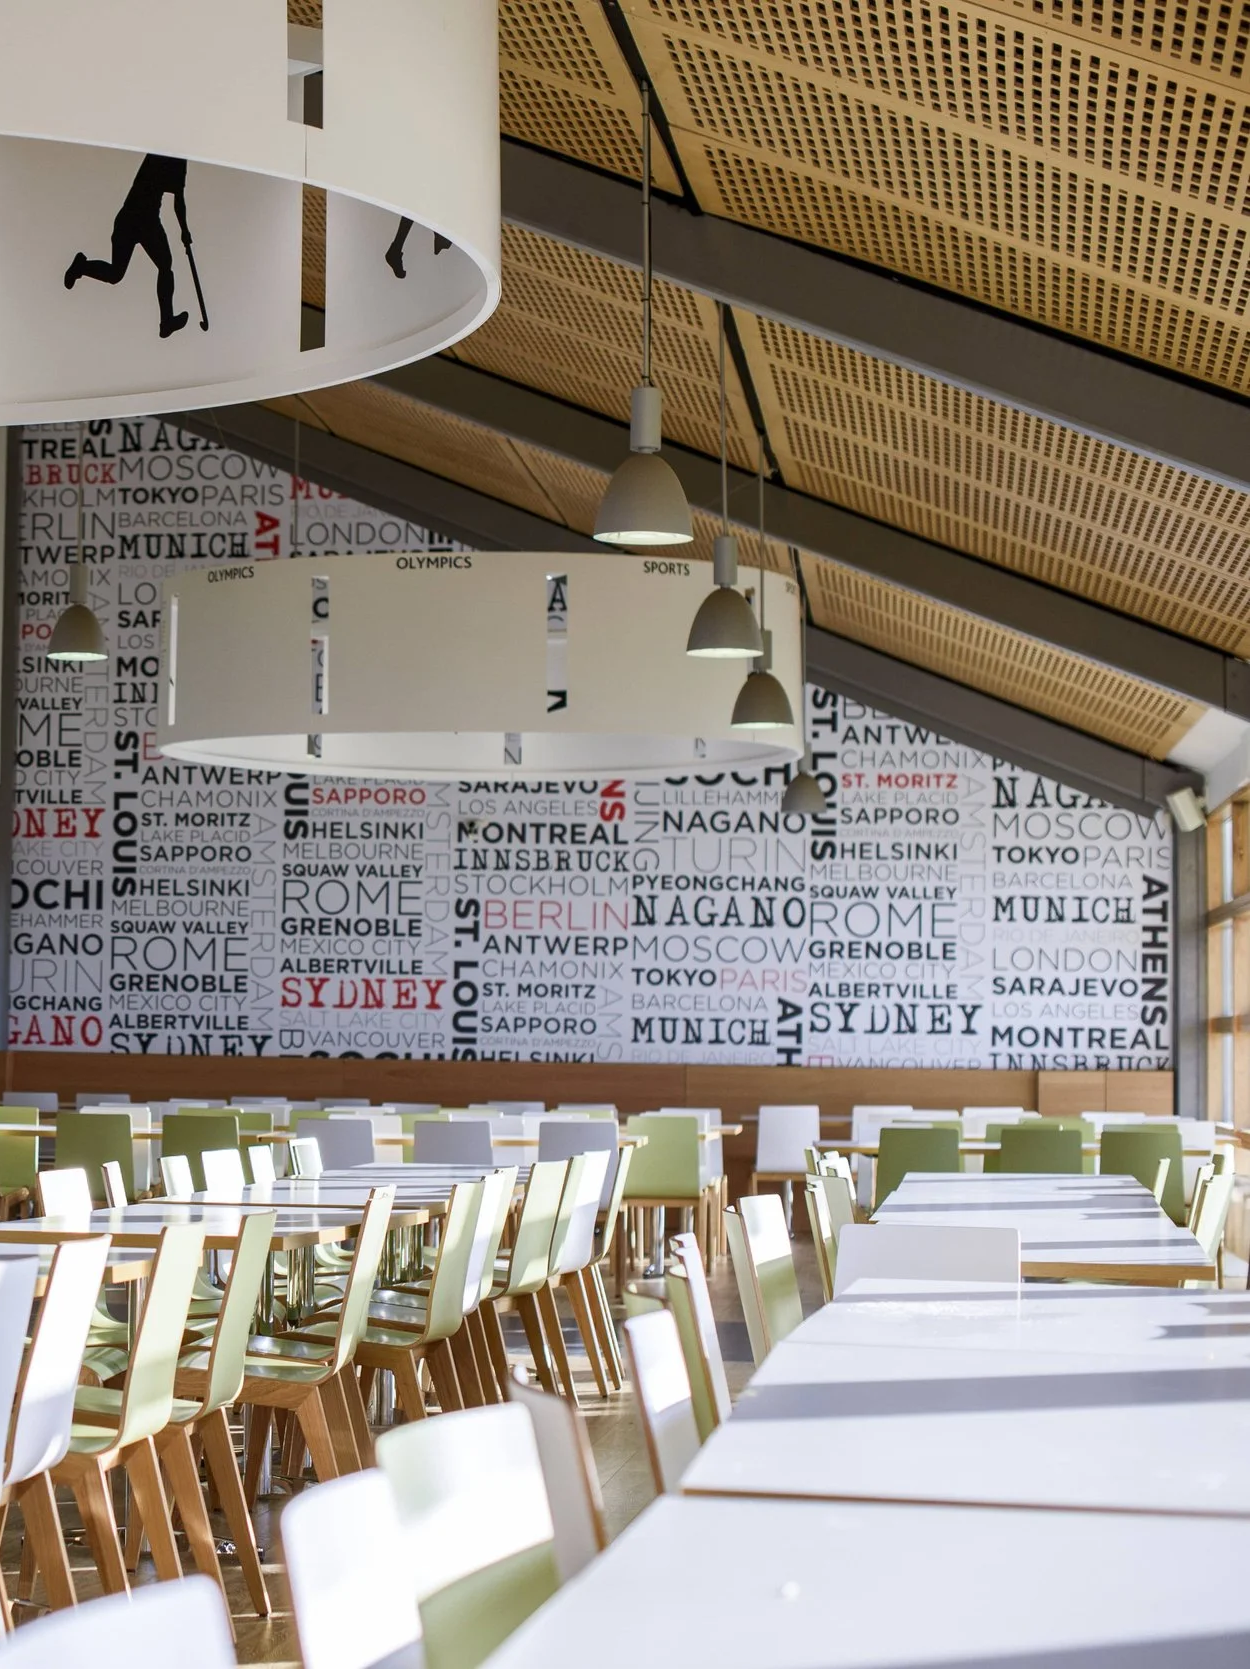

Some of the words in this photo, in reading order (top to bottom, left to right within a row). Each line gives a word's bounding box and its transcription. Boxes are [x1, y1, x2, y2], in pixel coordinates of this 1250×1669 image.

[119, 454, 279, 481] MOSCOW
[119, 486, 199, 505] TOKYO
[202, 484, 284, 506] PARIS
[119, 511, 246, 528] BARCELONA
[290, 522, 424, 546] LONDON
[118, 532, 249, 559] MUNICH
[396, 557, 472, 570] OLYMPICS
[643, 561, 691, 576] SPORTS
[207, 567, 255, 583] OLYMPICS
[118, 634, 153, 650] LOS
[812, 688, 837, 739] ST.
[114, 731, 139, 779] ST.
[841, 750, 986, 769] CHAMONIX
[34, 770, 79, 785] CITY
[141, 766, 281, 785] ANTWERP
[841, 774, 868, 789] ST.
[877, 774, 958, 789] MORITZ
[312, 788, 426, 805] SAPPORO
[458, 781, 598, 794] SARAJEVO
[141, 790, 277, 808] CHAMONIX
[841, 792, 887, 805] LAKE
[895, 792, 958, 805] PLACID
[458, 800, 496, 816] LOS
[503, 800, 597, 816] ANGELES
[841, 808, 960, 826] SAPPORO
[141, 813, 168, 827] ST.
[175, 813, 250, 827] MORITZ
[663, 811, 805, 833] NAGANO
[993, 813, 1165, 840] MOSCOW
[140, 830, 184, 843] LAKE
[190, 830, 250, 843] PLACID
[312, 822, 424, 840] HELSINKI
[457, 823, 629, 845] MONTREAL
[59, 841, 104, 857] CITY
[112, 791, 138, 897] LOUIS
[283, 843, 423, 860] MELBOURNE
[841, 843, 957, 860] HELSINKI
[140, 846, 251, 863] SAPPORO
[453, 849, 630, 872] INNSBRUCK
[663, 837, 805, 873] TURIN
[993, 847, 1079, 864] TOKYO
[1084, 847, 1170, 870] PARIS
[283, 864, 348, 877] SQUAW
[355, 864, 423, 877] VALLEY
[811, 864, 958, 882] MELBOURNE
[140, 880, 249, 897] HELSINKI
[454, 874, 628, 896] STOCKHOLM
[632, 875, 805, 892] PYEONGCHANG
[958, 775, 986, 1000] AMSTERDAM
[993, 872, 1132, 890] BARCELONA
[283, 880, 423, 915] ROME
[810, 886, 879, 899] SQUAW
[887, 886, 957, 900] VALLEY
[111, 900, 249, 917] MELBOURNE
[485, 900, 628, 930] BERLIN
[631, 895, 805, 928] NAGANO
[993, 896, 1136, 924] MUNICH
[111, 921, 177, 935] SQUAW
[182, 921, 249, 935] VALLEY
[251, 813, 276, 1032] AMSTERDAM
[282, 918, 422, 937] GRENOBLE
[454, 898, 480, 947] ST.
[810, 902, 957, 938] ROME
[111, 937, 249, 972] ROME
[281, 938, 364, 956] MEXICO
[372, 938, 420, 956] CITY
[483, 936, 628, 956] ANTWERP
[633, 935, 805, 963] MOSCOW
[809, 941, 957, 960] GRENOBLE
[1141, 874, 1169, 1026] ATHENS
[280, 958, 423, 975] ALBERTVILLE
[993, 947, 1137, 973] LONDON
[482, 959, 623, 980] CHAMONIX
[631, 968, 716, 986] TOKYO
[809, 963, 896, 980] MEXICO
[905, 963, 956, 980] CITY
[110, 974, 248, 993] GRENOBLE
[721, 968, 808, 993] PARIS
[992, 977, 1138, 997] SARAJEVO
[281, 977, 447, 1010] SYDNEY
[483, 983, 509, 997] ST.
[518, 984, 595, 998] MORITZ
[808, 983, 958, 999] ALBERTVILLE
[110, 995, 192, 1011] MEXICO
[199, 995, 247, 1011] CITY
[452, 960, 478, 1061] LOUIS
[481, 1001, 525, 1014] LAKE
[534, 1002, 596, 1015] PLACID
[632, 994, 767, 1011] BARCELONA
[992, 1003, 1032, 1018] LOS
[1040, 1004, 1140, 1020] ANGELES
[109, 1014, 249, 1030] ALBERTVILLE
[279, 1011, 333, 1029] SALT
[337, 1011, 394, 1029] LAKE
[400, 1011, 445, 1029] CITY
[481, 1017, 597, 1035] SAPPORO
[810, 1002, 983, 1035] SYDNEY
[307, 1031, 445, 1049] VANCOUVER
[631, 1017, 770, 1045] MUNICH
[992, 1026, 1169, 1050] MONTREAL
[111, 1034, 273, 1056] SYDNEY
[808, 1037, 861, 1053] SALT
[867, 1038, 927, 1053] LAKE
[934, 1038, 982, 1054] CITY
[481, 1050, 595, 1063] HELSINKI
[988, 1053, 1169, 1071] INNSBRUCK
